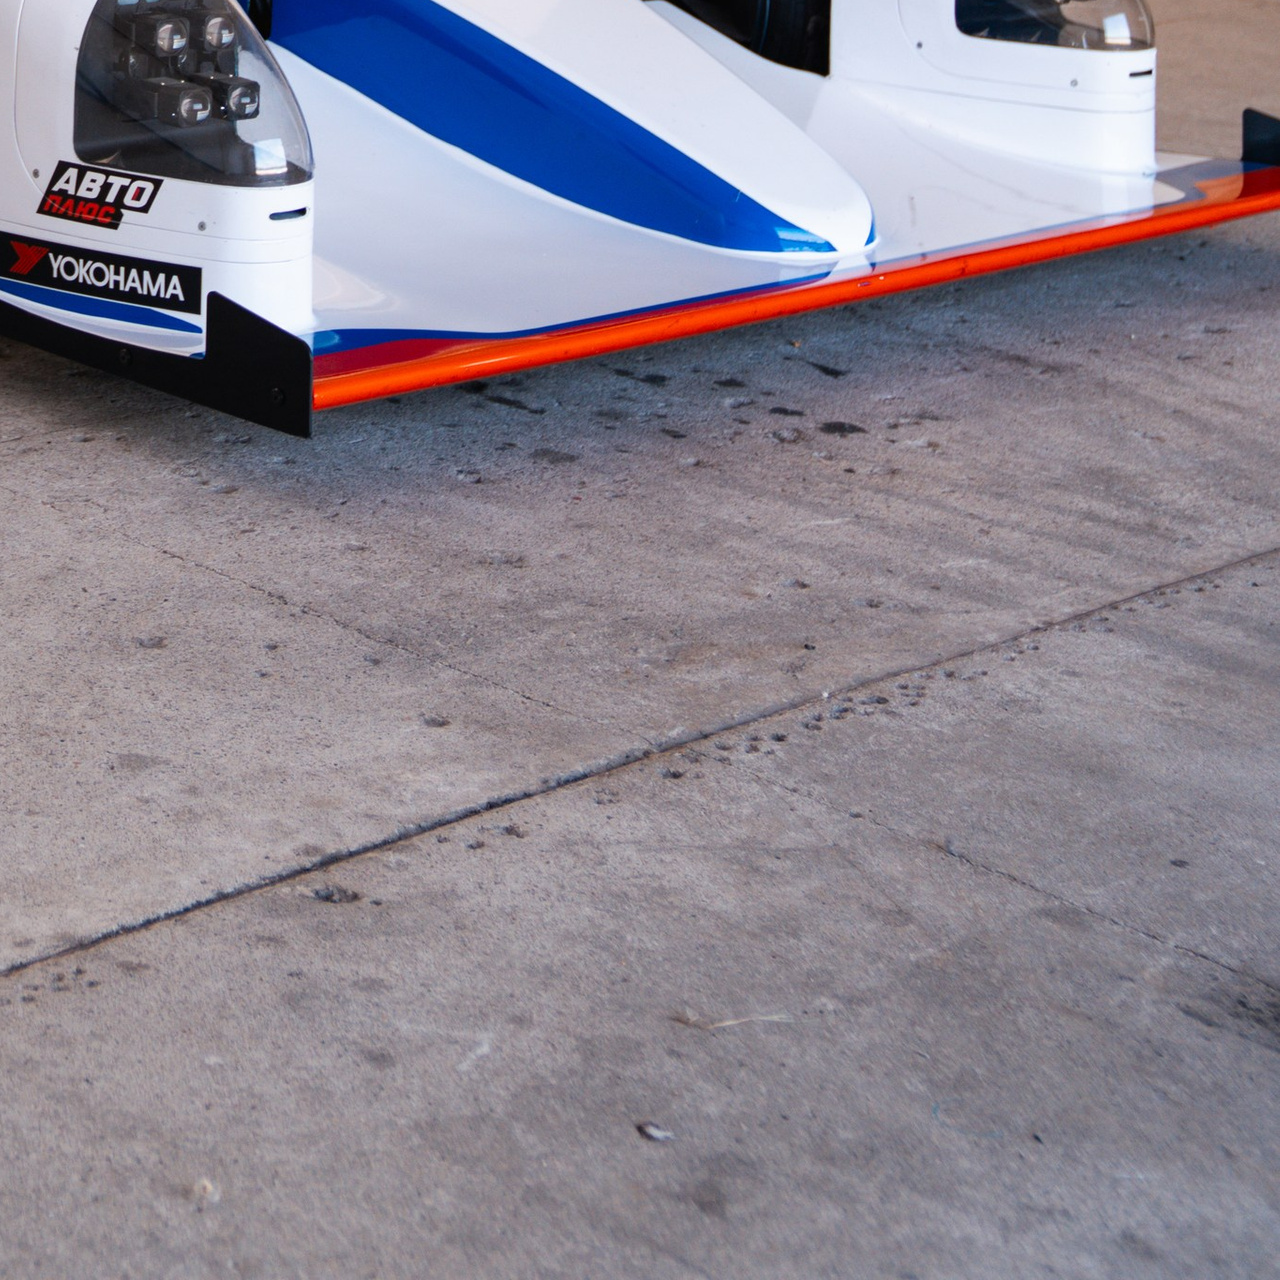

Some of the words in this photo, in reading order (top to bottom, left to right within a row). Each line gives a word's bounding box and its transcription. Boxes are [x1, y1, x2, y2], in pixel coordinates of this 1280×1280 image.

[51, 167, 155, 208] АВТО
[43, 194, 116, 224] ПЛЮС
[48, 252, 185, 302] YOKOHAMA
